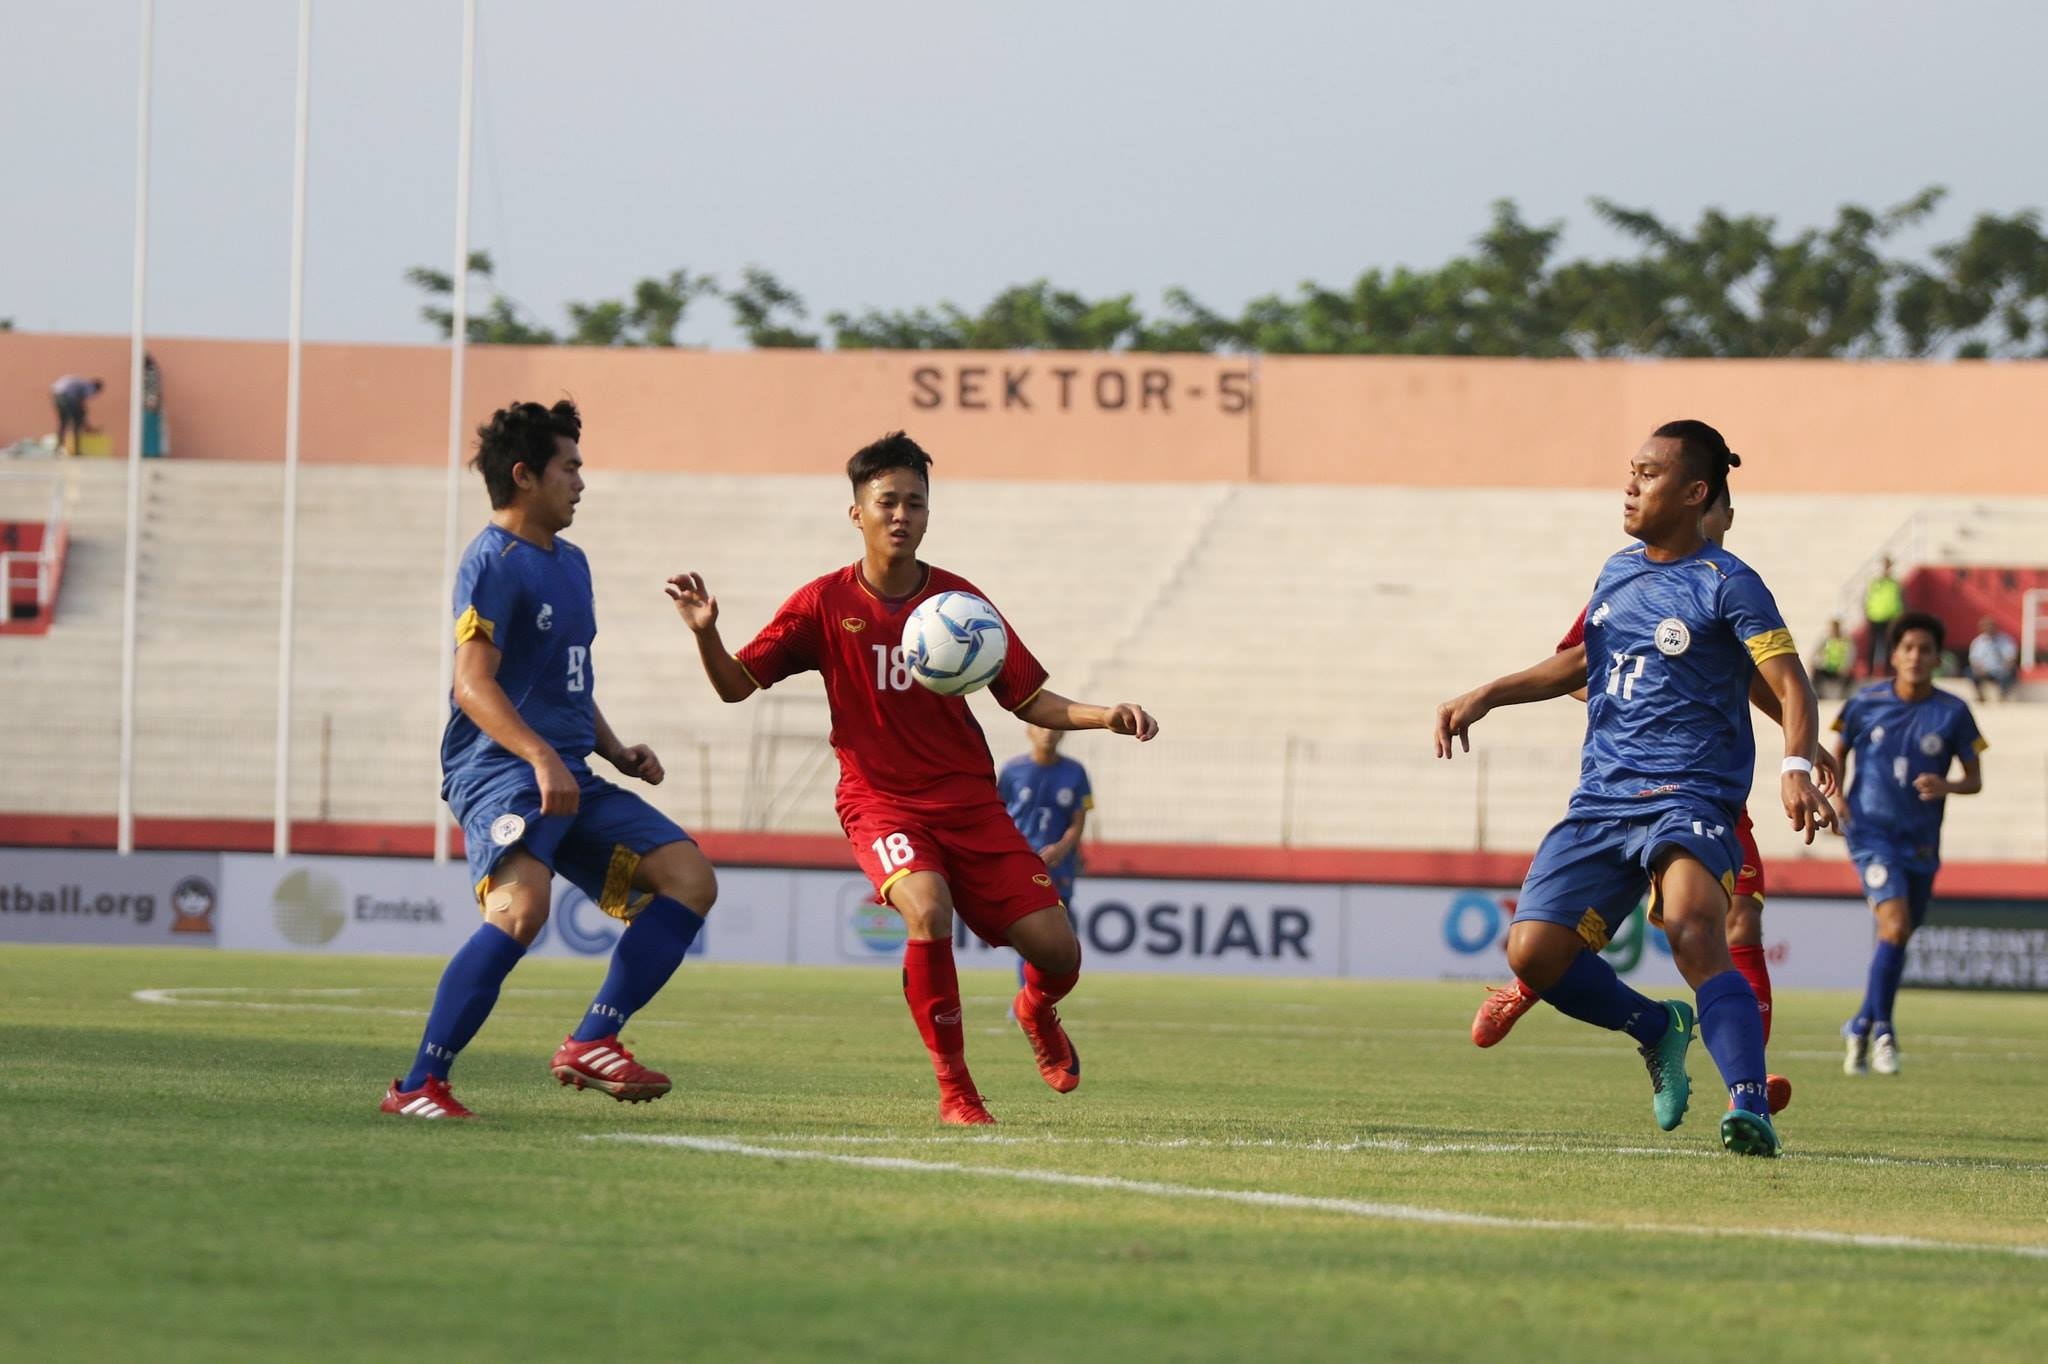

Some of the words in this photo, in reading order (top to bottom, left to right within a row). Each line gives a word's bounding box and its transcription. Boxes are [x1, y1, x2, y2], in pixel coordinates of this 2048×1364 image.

[911, 365, 1251, 414] SEKTOR-5
[567, 645, 587, 692] 9
[871, 643, 913, 691] 18
[1606, 652, 1646, 700] 17
[871, 832, 915, 874] 18
[354, 893, 446, 923] Emtek
